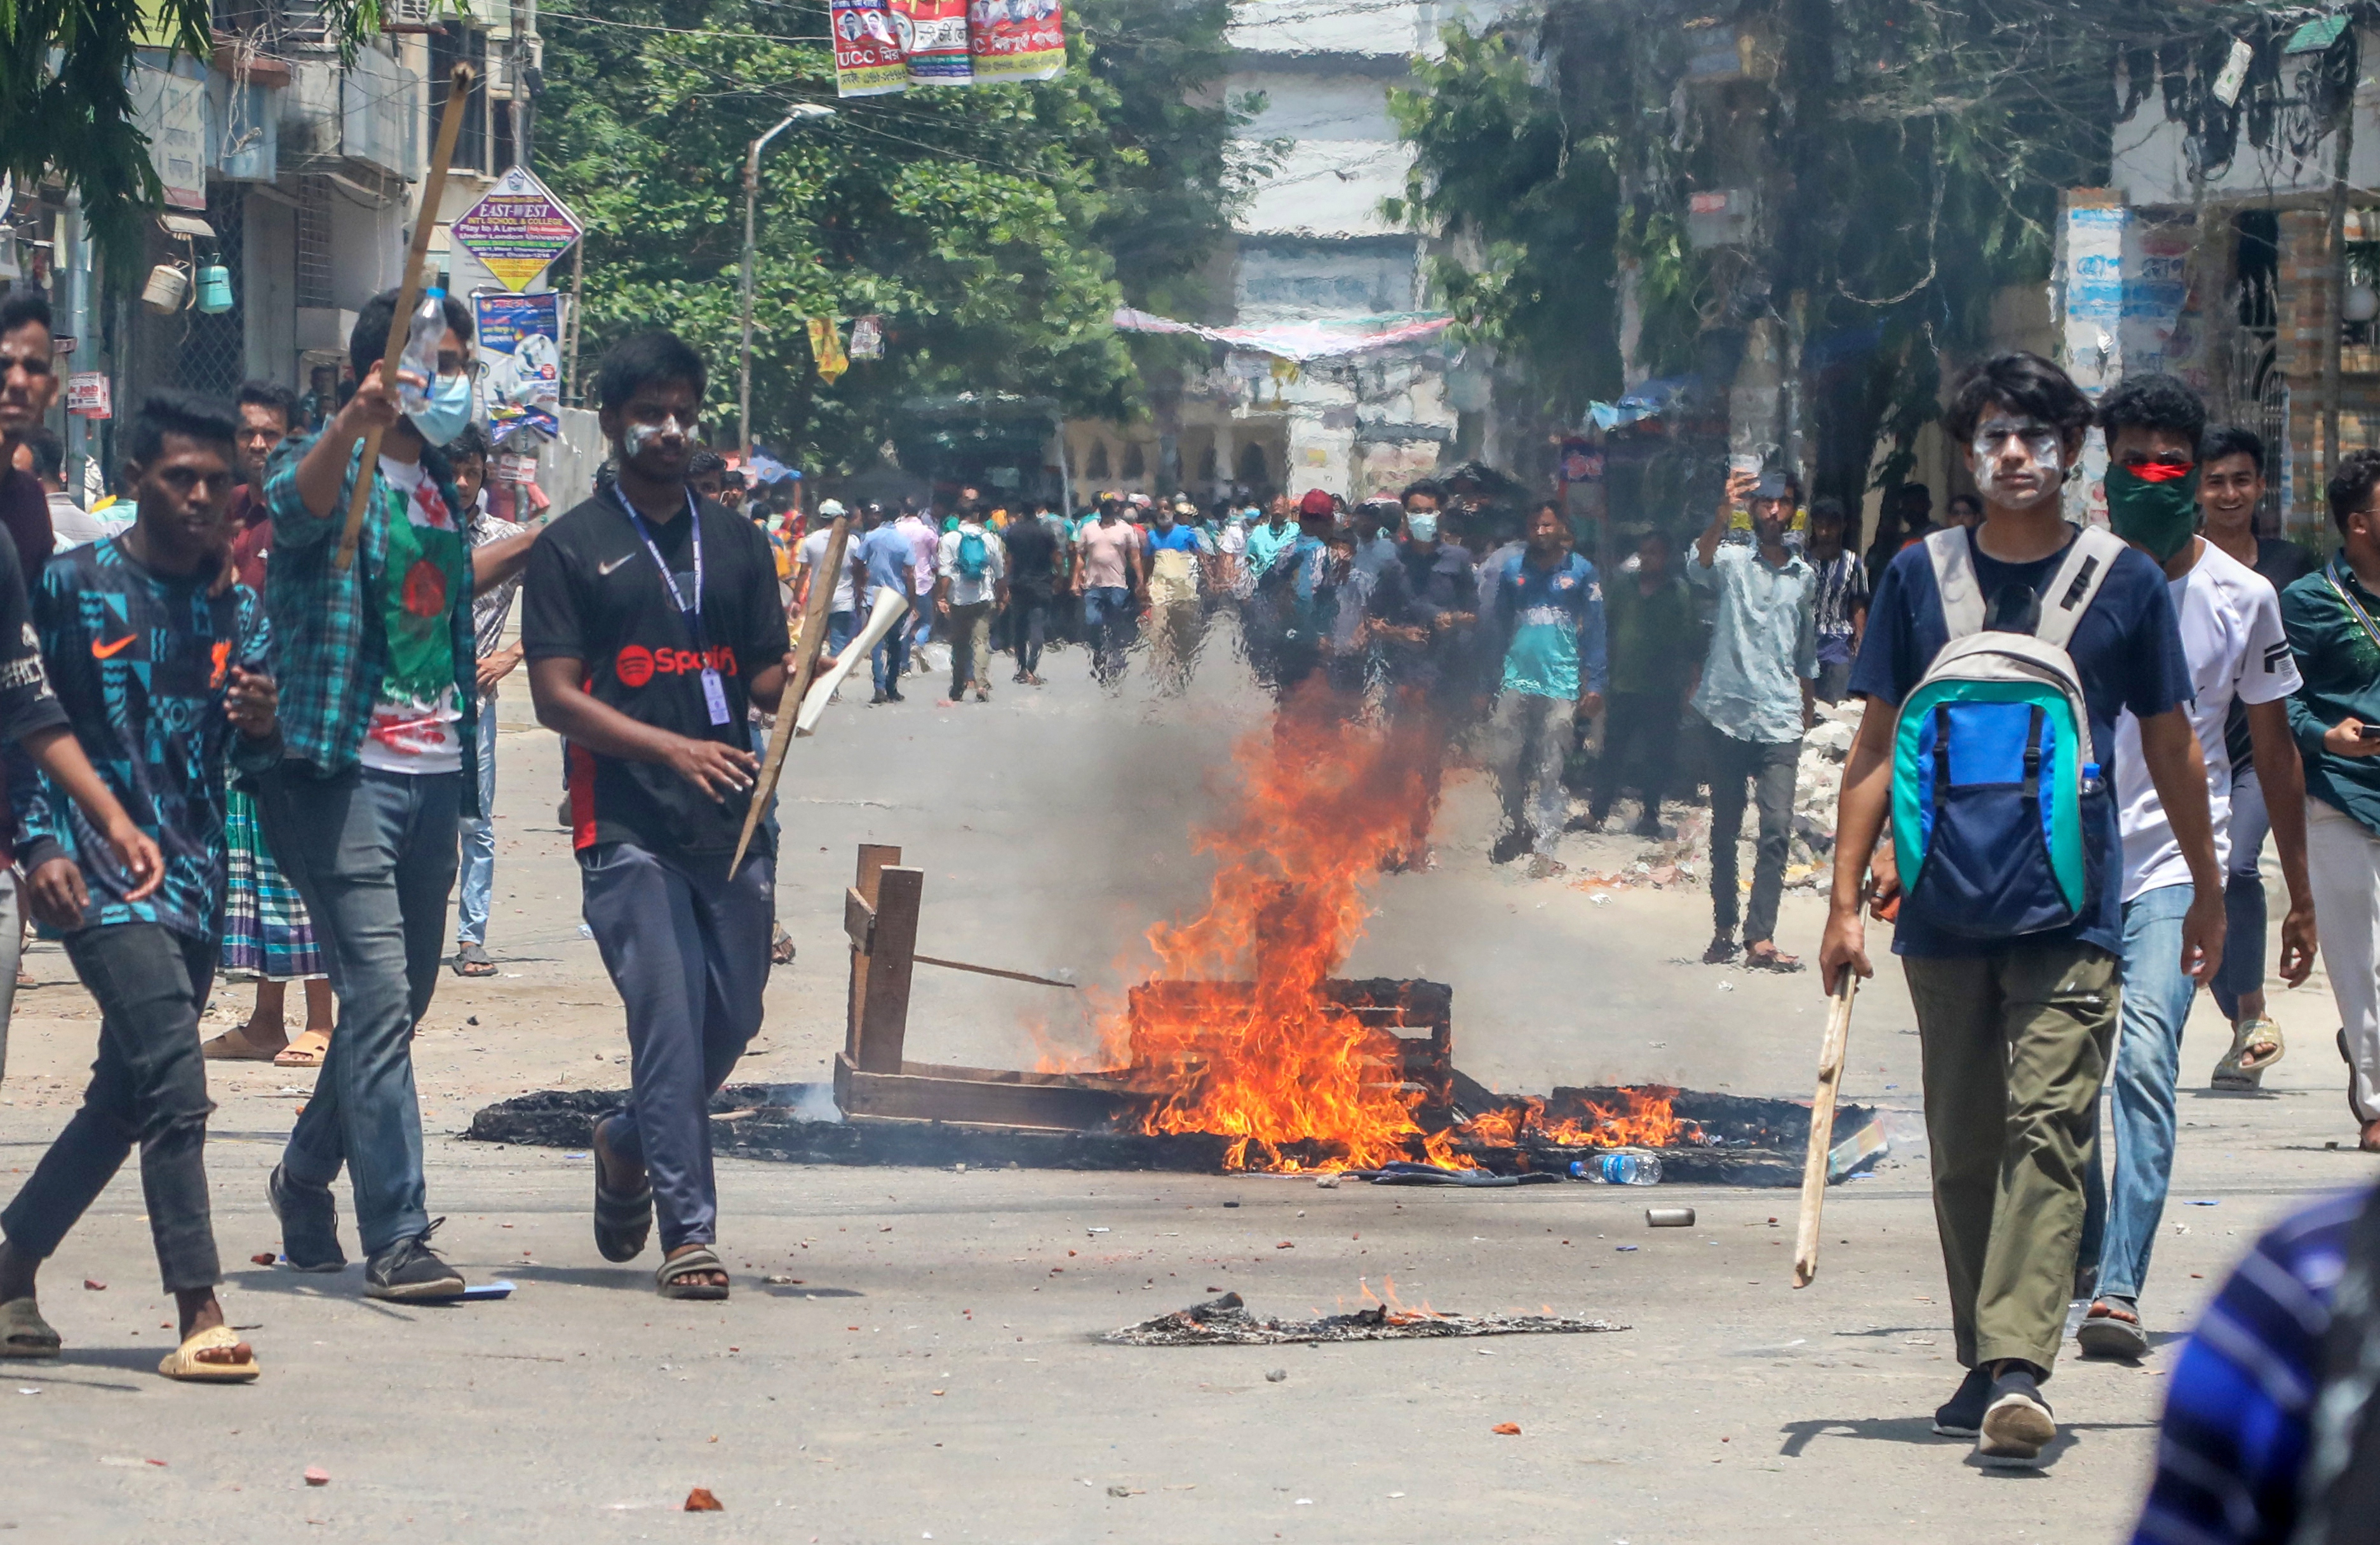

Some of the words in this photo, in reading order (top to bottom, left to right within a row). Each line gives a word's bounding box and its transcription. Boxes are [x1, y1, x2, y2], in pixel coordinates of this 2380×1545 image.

[837, 50, 875, 67] UCC
[480, 204, 549, 217] EAST-EST
[655, 645, 737, 676] Spoify
